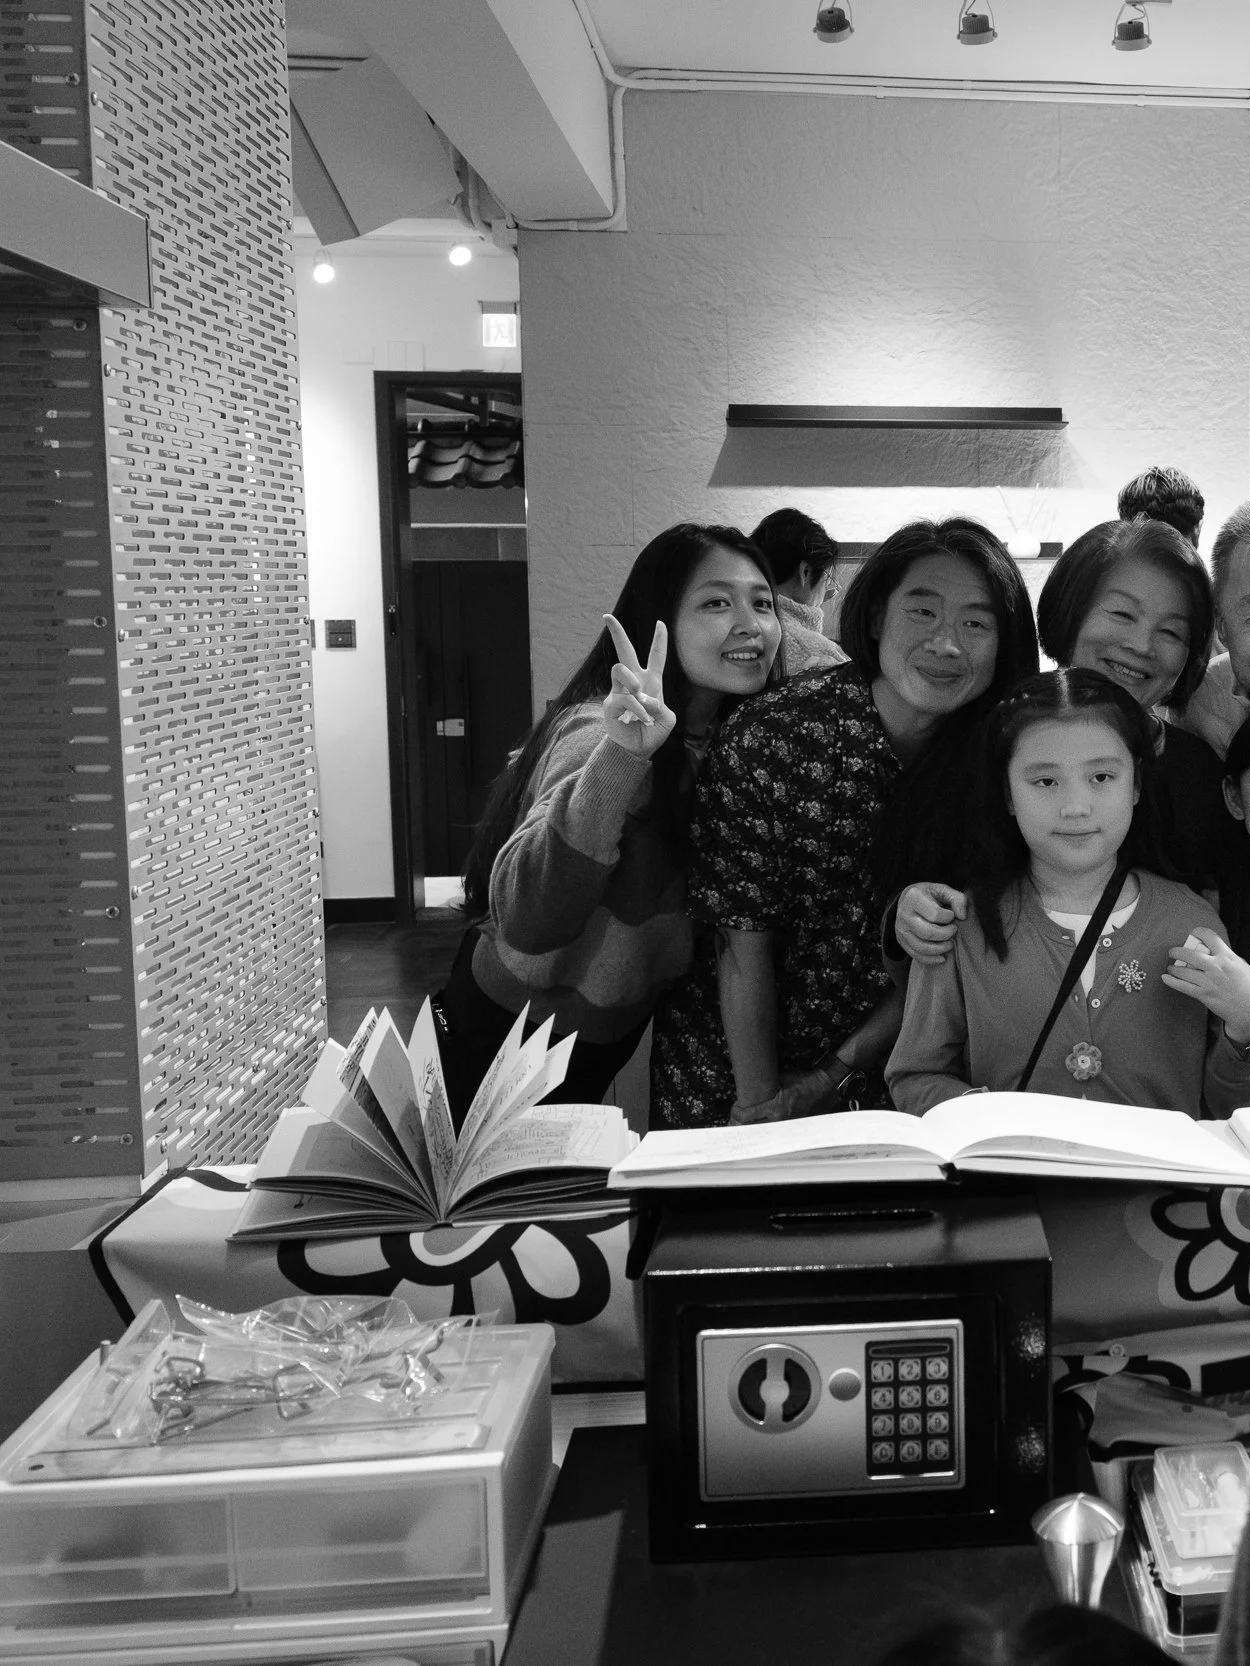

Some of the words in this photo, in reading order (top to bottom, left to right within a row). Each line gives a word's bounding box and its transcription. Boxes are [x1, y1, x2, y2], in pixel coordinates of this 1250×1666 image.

[906, 1364, 913, 1375] 2
[934, 1363, 941, 1375] 3
[879, 1392, 887, 1403] 4
[907, 1392, 914, 1403] 5
[934, 1390, 941, 1401] 6
[934, 1417, 942, 1429] 9
